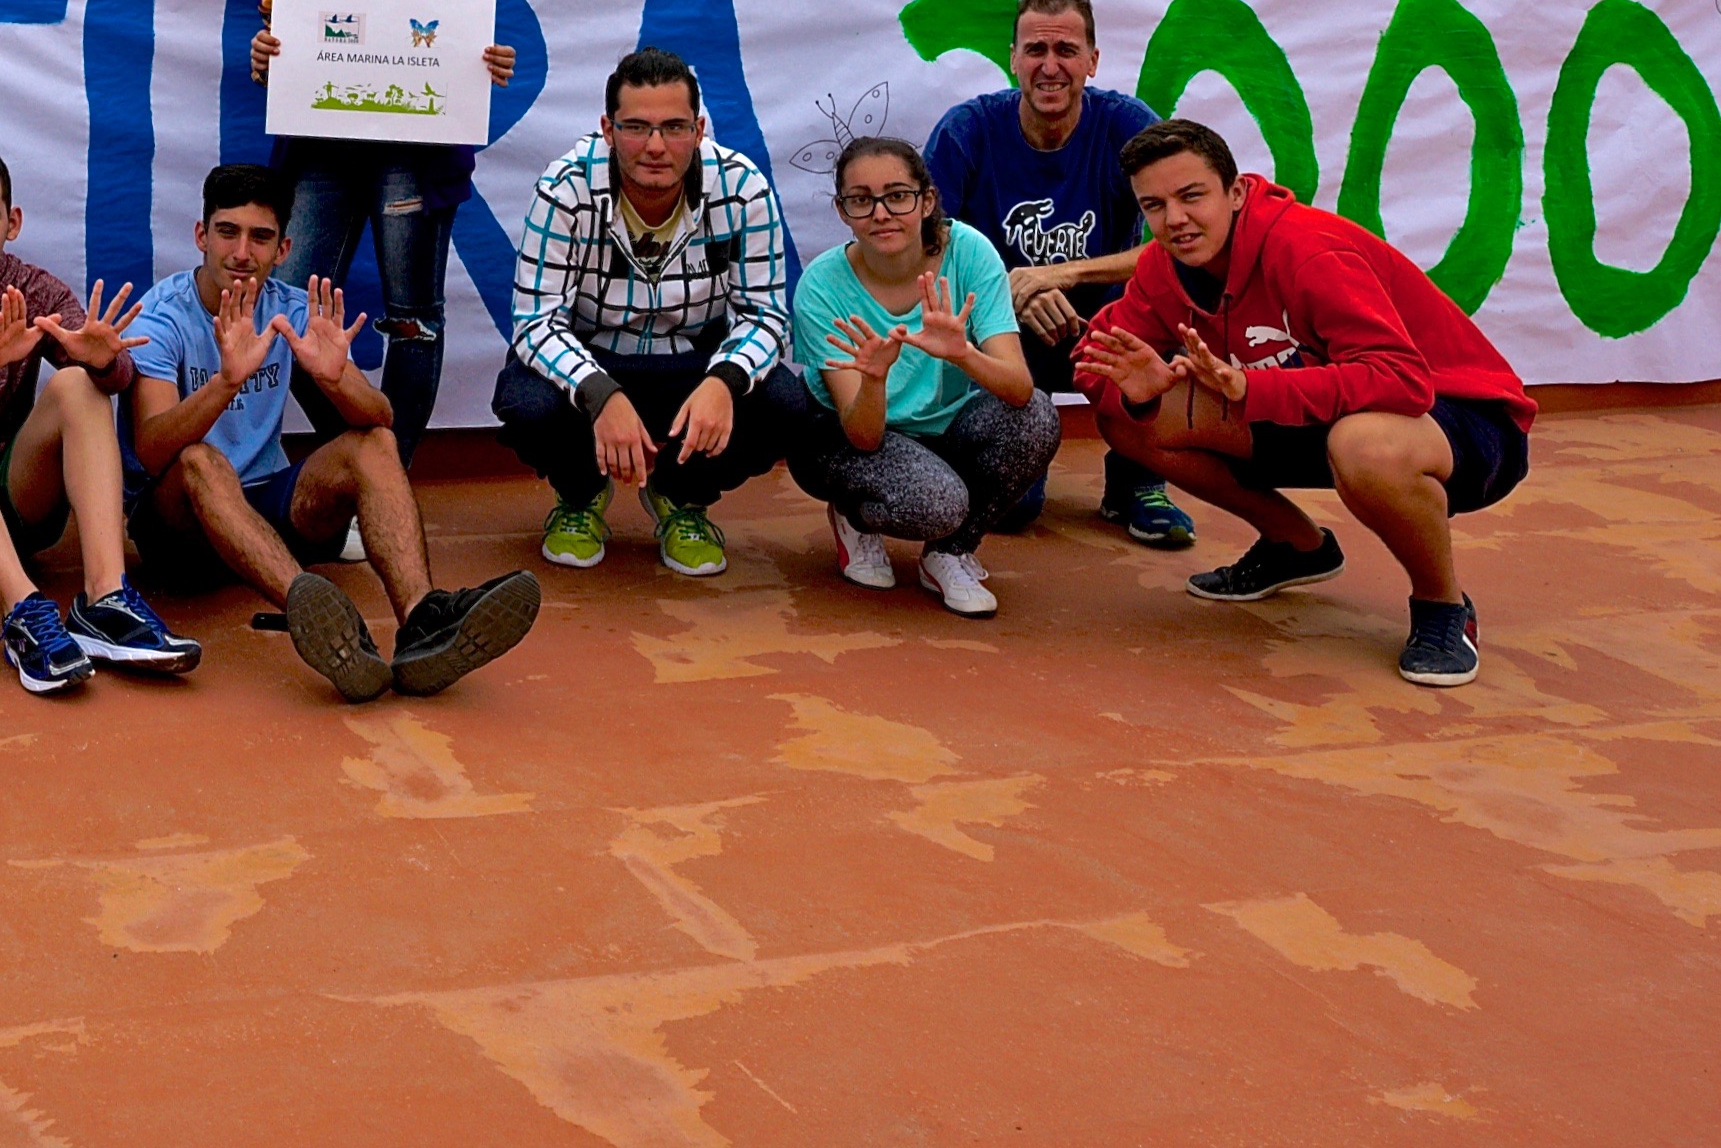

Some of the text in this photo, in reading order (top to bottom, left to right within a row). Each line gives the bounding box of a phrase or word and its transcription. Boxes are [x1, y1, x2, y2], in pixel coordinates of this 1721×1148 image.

[316, 50, 440, 68] ÁREA MARINA LA ISLETA
